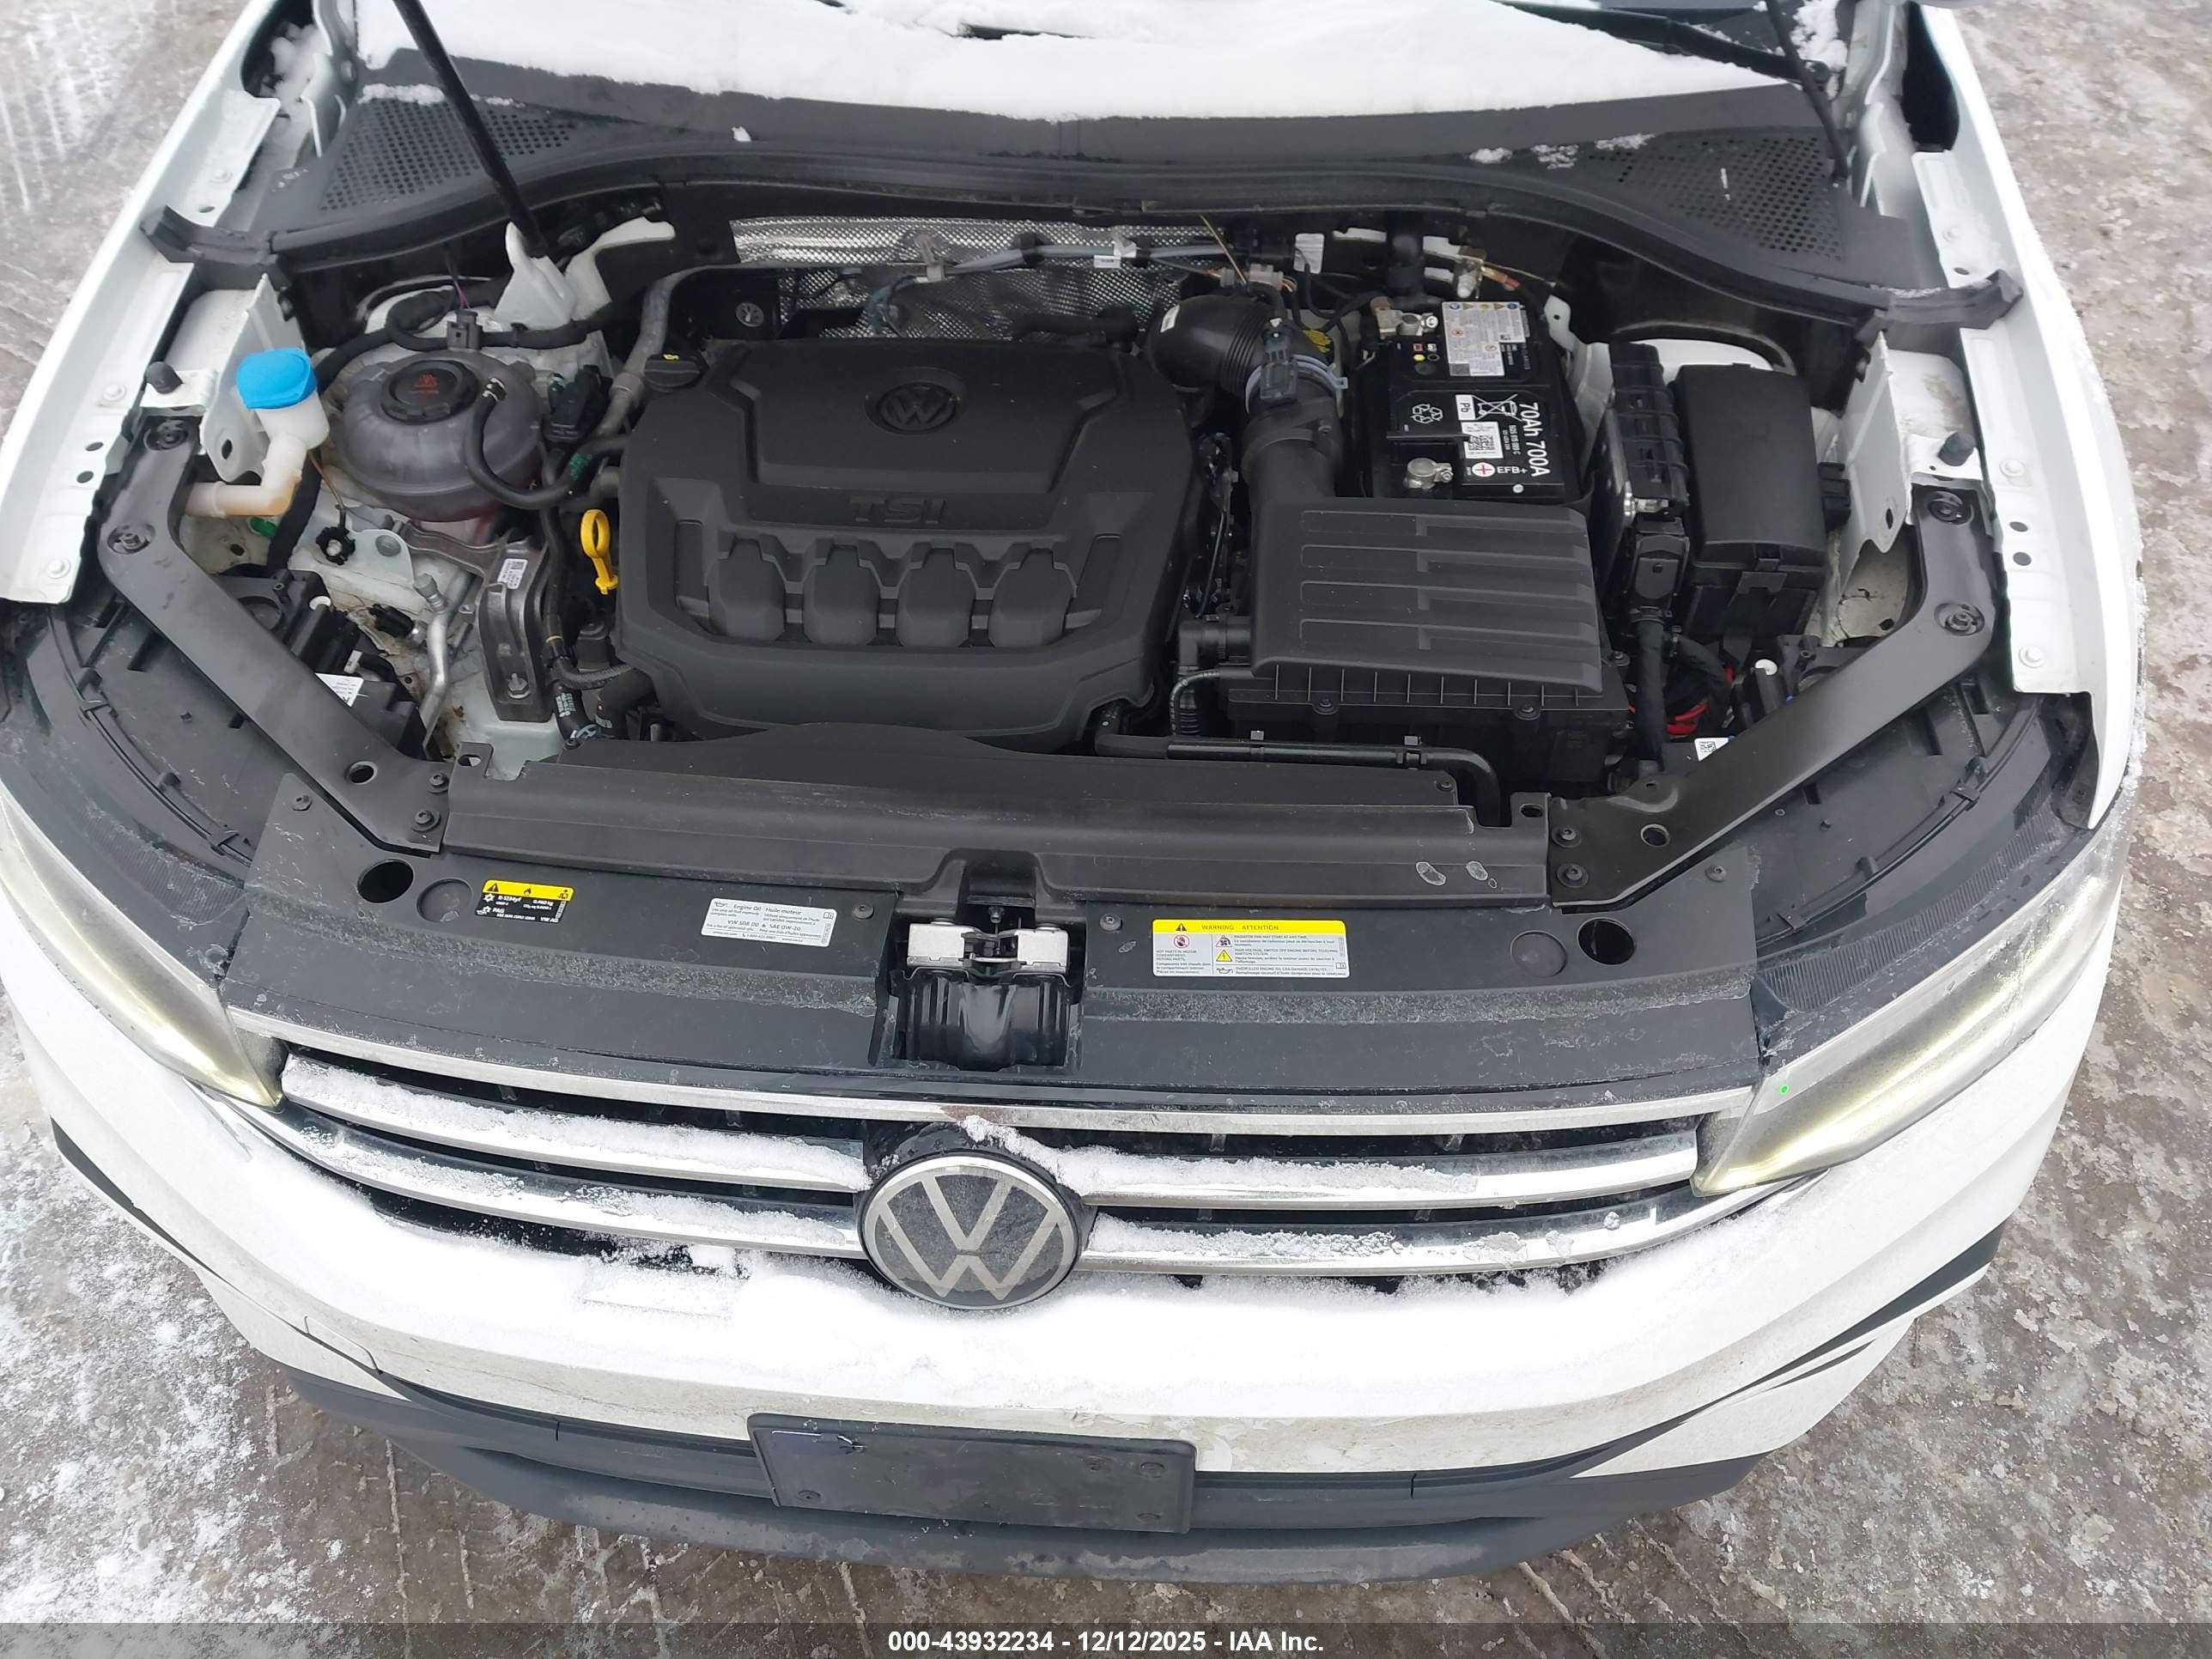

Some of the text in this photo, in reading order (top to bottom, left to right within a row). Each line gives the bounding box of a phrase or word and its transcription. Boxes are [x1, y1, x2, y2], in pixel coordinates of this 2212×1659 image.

[1460, 402, 1471, 413] Pb
[1519, 402, 1551, 477] 70Ah 700A
[1497, 465, 1528, 474] EFB+
[850, 495, 945, 523] TSI
